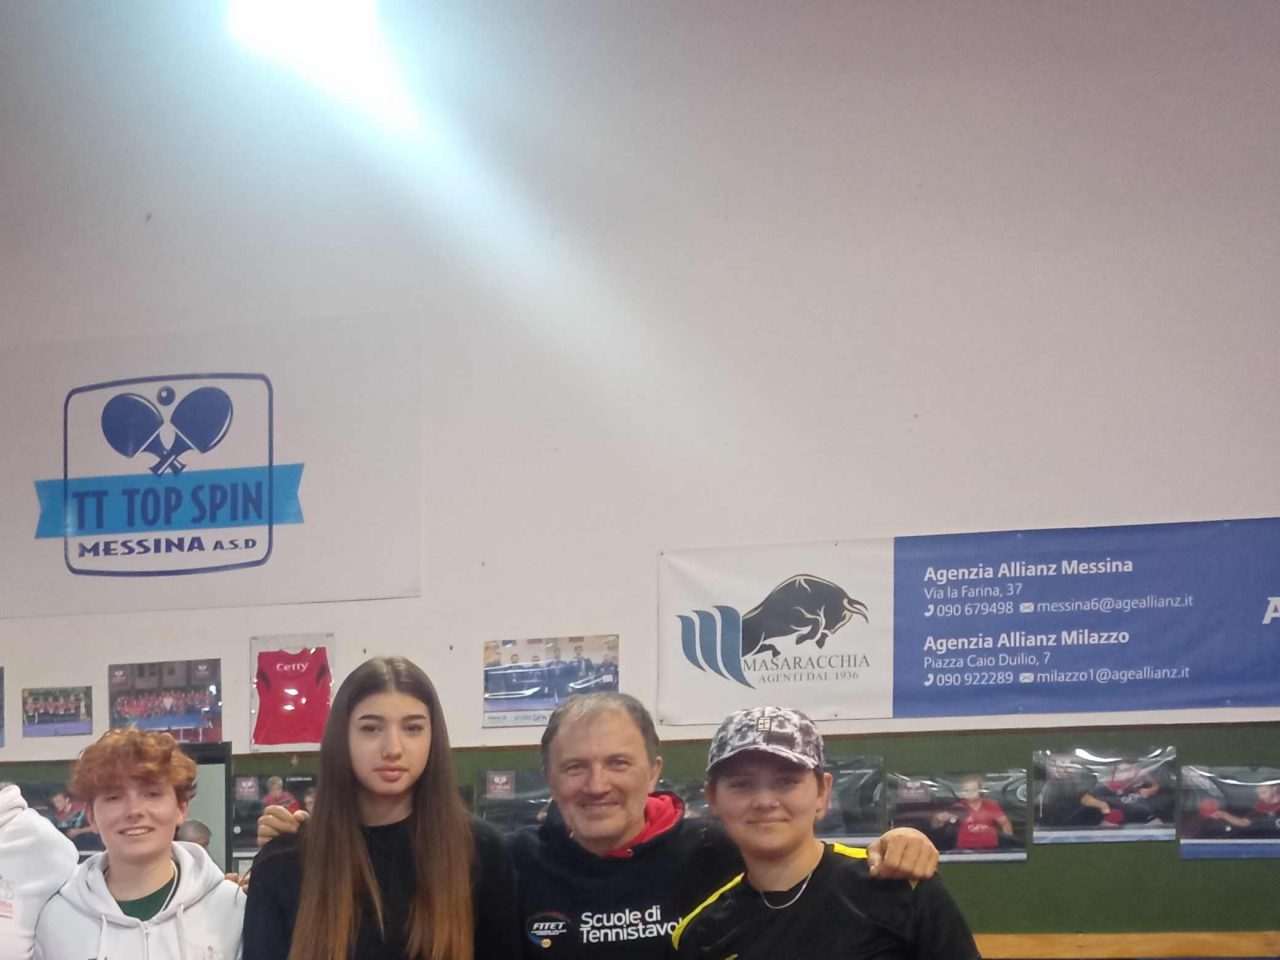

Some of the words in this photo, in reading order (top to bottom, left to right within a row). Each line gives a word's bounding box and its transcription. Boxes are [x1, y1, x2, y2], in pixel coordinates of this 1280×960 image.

[72, 490, 109, 530] TT
[122, 487, 184, 527] TOP
[191, 480, 263, 523] SPIN
[78, 536, 205, 557] MESSINA
[924, 565, 994, 584] Agenzia
[998, 561, 1057, 578] Allianz
[1061, 558, 1133, 576] Messina
[924, 587, 945, 600] Via
[947, 586, 958, 598] la
[962, 584, 1003, 600] Farina,
[1007, 583, 1022, 596] 37
[936, 604, 961, 617] 090
[965, 602, 1013, 616] 679498
[1037, 594, 1193, 614] messina6@ageallianz.it
[924, 635, 993, 654] Agenzia
[997, 632, 1057, 649] Allianz
[1061, 629, 1130, 646] Milazzo
[743, 654, 870, 672] MASARACCHIA
[924, 656, 964, 669] Piazza
[967, 654, 995, 667] Caio
[998, 652, 1039, 668] Duilio,
[1043, 652, 1051, 665] 7
[760, 672, 803, 683] AGENTI
[807, 671, 827, 681] DAL
[835, 671, 859, 680] 1936
[936, 674, 961, 686] 090
[964, 672, 1013, 685] 922289
[1037, 667, 1190, 685] milazzo1@ageallianz.it
[532, 921, 566, 931] FITET
[580, 908, 642, 928] Scuole
[645, 905, 661, 922] di
[580, 917, 683, 944] Tennistavo
